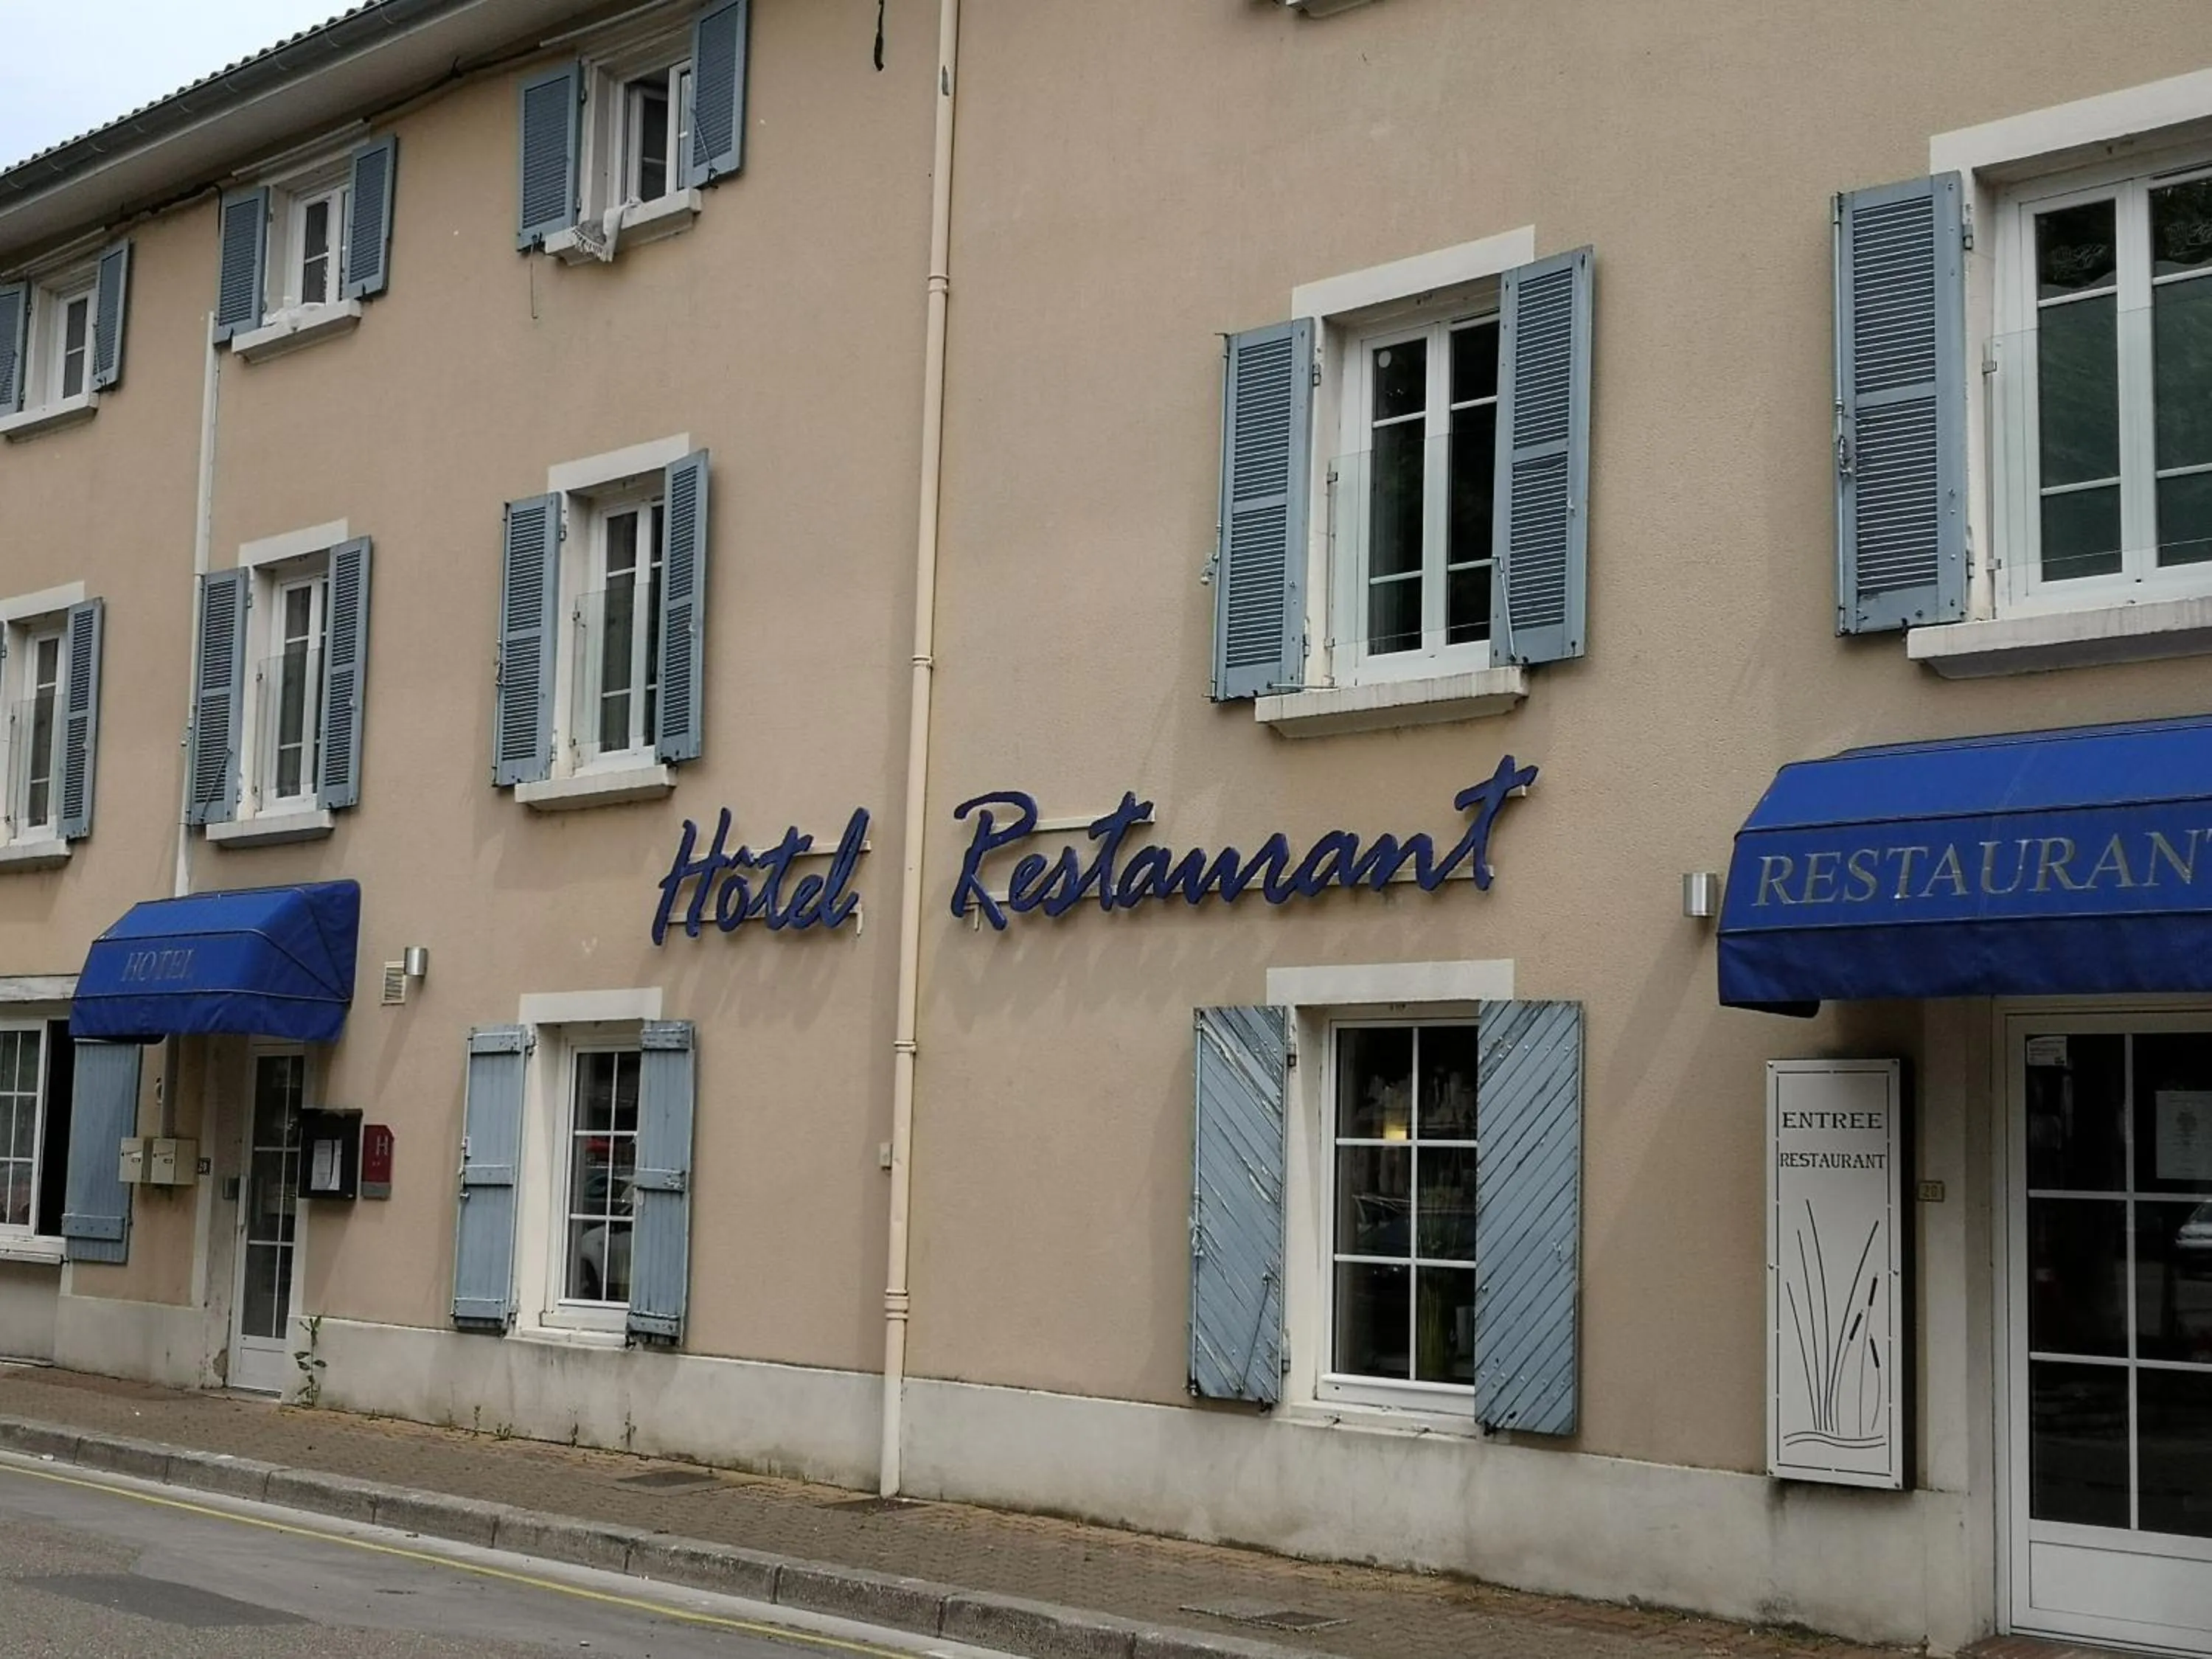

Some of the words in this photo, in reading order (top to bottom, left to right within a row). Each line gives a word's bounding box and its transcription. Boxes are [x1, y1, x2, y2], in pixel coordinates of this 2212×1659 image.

[652, 807, 869, 945] Hôtel
[951, 754, 1540, 931] Restaurant
[1750, 828, 2212, 906] RESTAURAN
[120, 947, 195, 982] HOTEL
[1781, 1111, 1883, 1129] ENTREE
[375, 1135, 389, 1156] H
[1779, 1152, 1886, 1169] RESTAURANT
